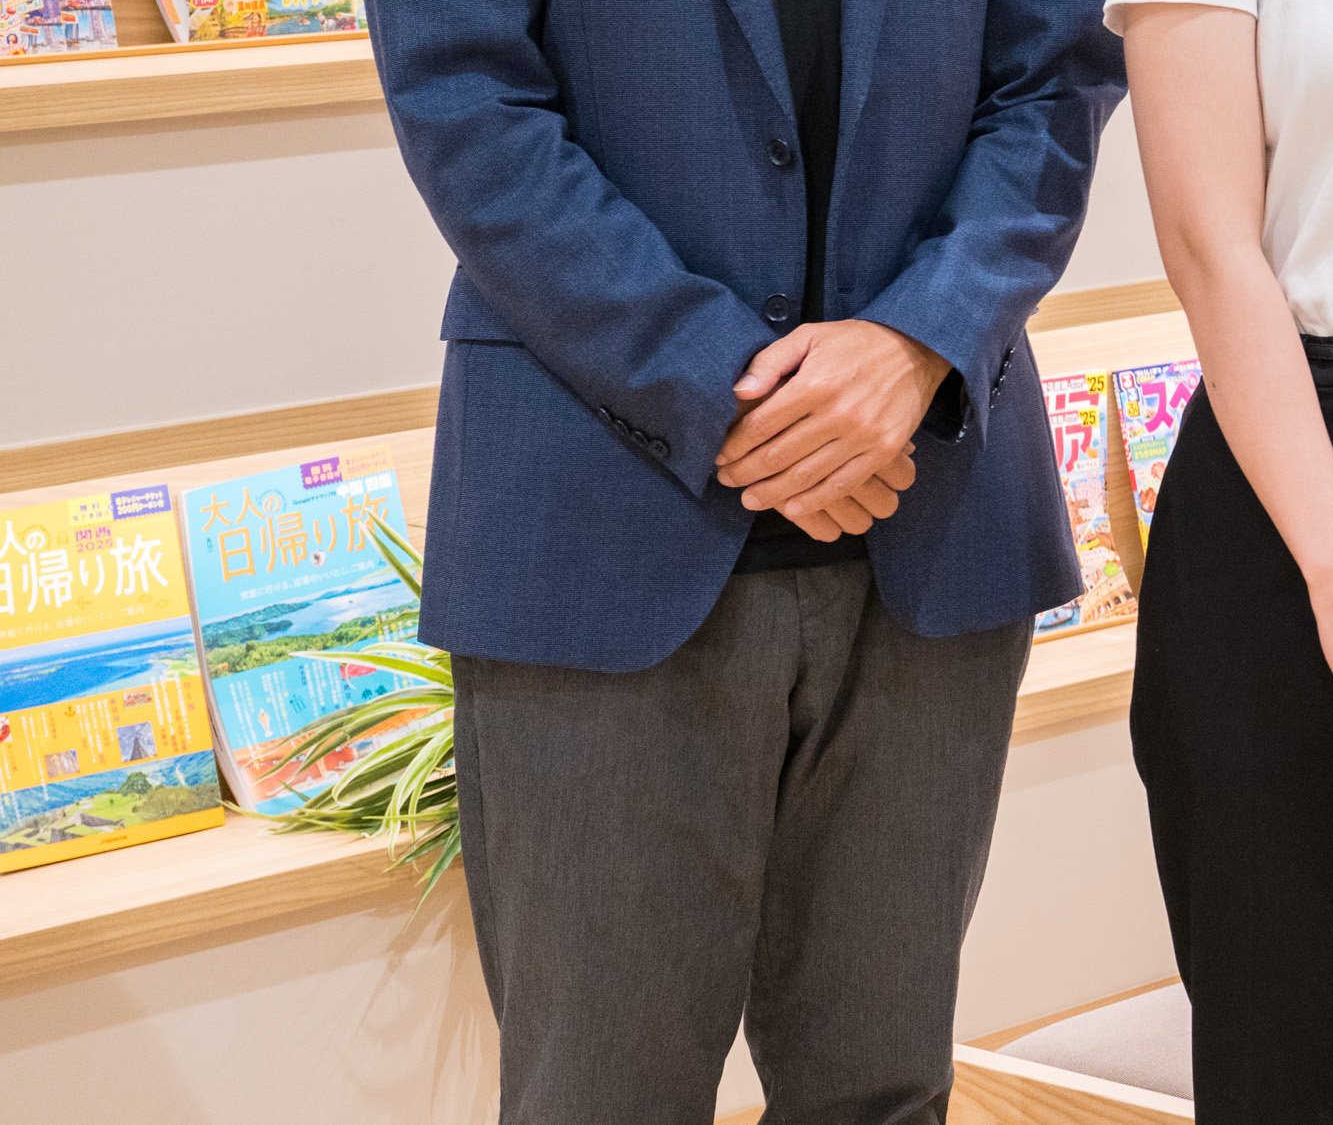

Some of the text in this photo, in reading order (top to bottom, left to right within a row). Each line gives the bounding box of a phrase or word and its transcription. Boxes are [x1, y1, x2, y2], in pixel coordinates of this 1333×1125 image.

[200, 486, 282, 533] 大人の
[77, 539, 114, 554] 2025
[218, 492, 390, 583] 日帰り旅
